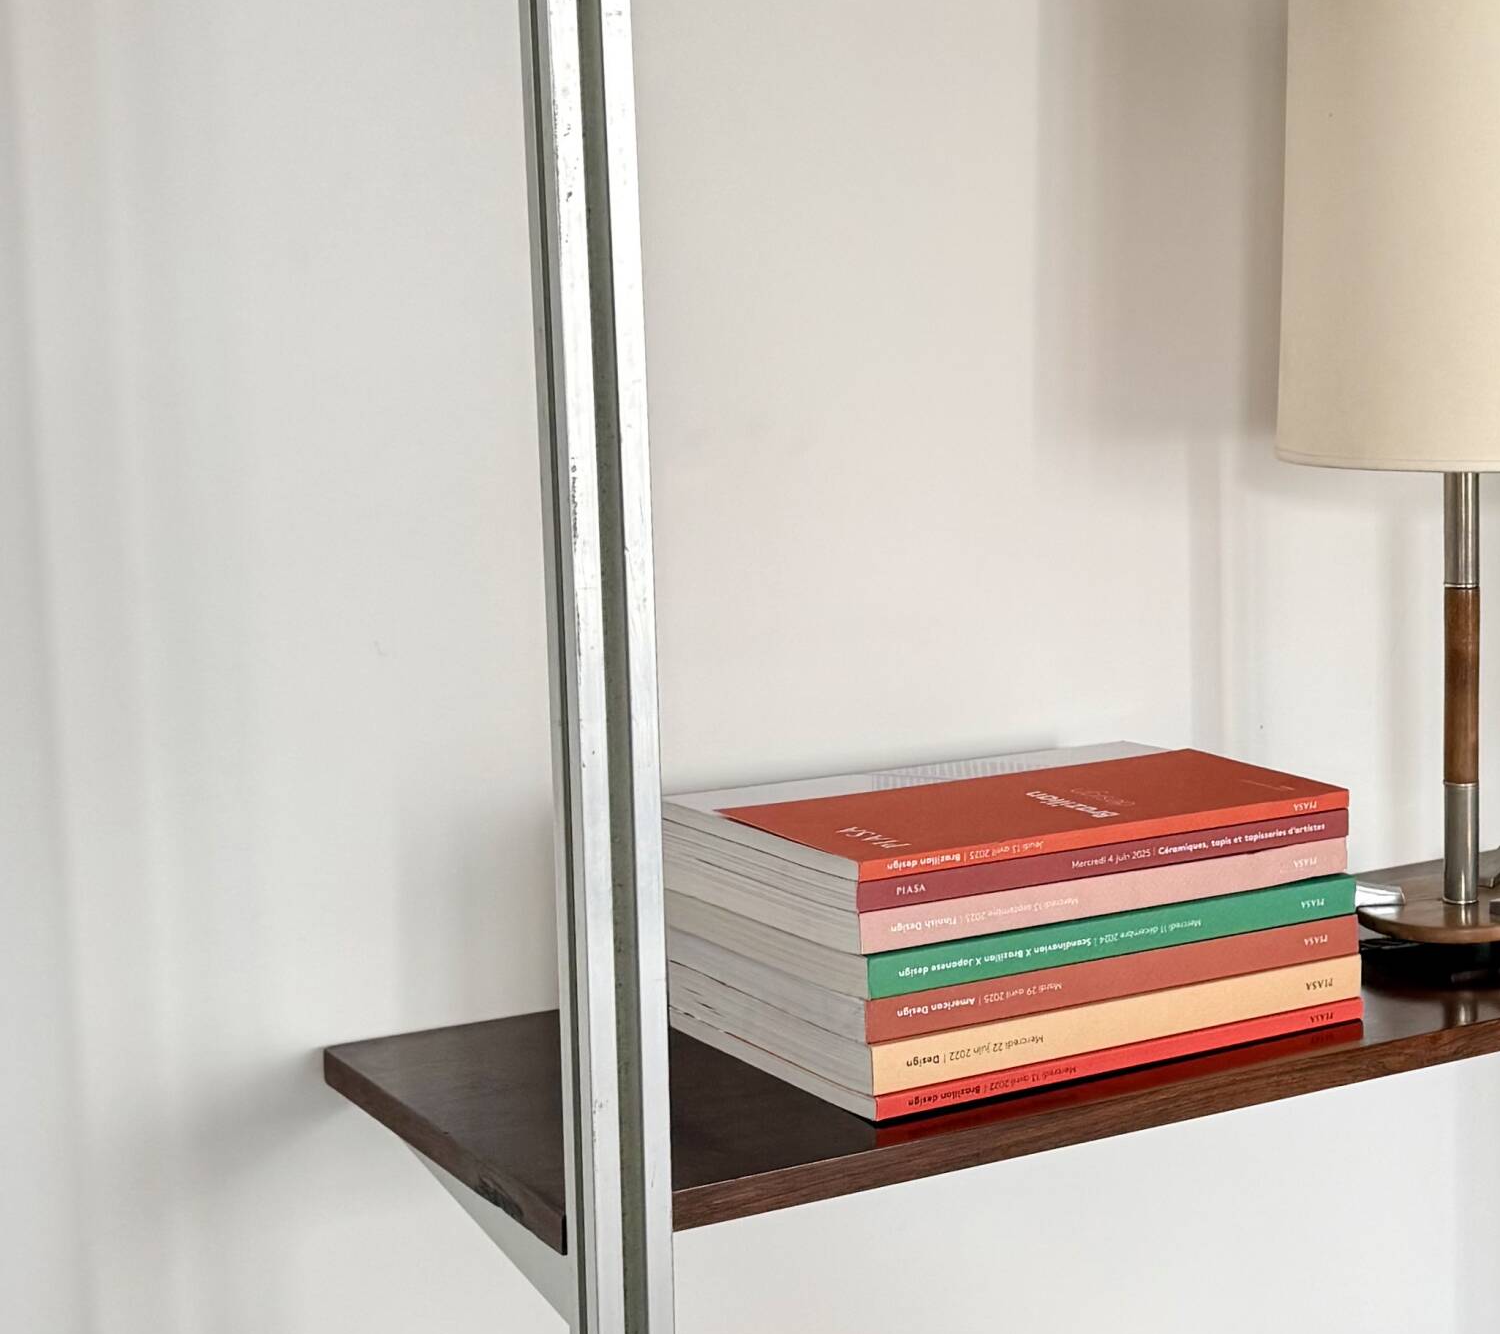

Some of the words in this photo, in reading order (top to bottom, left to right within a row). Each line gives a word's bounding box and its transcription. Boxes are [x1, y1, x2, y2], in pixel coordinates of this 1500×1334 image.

[1025, 790, 1119, 818] Brazilian
[1292, 800, 1317, 811] PIASA
[840, 825, 911, 847] PIASA
[991, 846, 1009, 856] avril
[1022, 840, 1044, 851] Jeudi
[886, 857, 917, 871] design
[895, 883, 925, 894] PIASA
[1071, 855, 1106, 869] Mercredi
[1107, 854, 1113, 862] 4
[1114, 852, 1130, 863] juin
[1131, 848, 1150, 859] 2025
[1157, 839, 1209, 856] Céramiques,
[1210, 836, 1231, 847] tapis
[1233, 835, 1242, 843] et
[1244, 827, 1286, 843] tapisseries
[1287, 822, 1325, 835] d'artistes
[919, 852, 960, 866] Brazilian
[1292, 856, 1317, 867] PIASA
[1043, 896, 1078, 910] Mercredi
[1300, 897, 1324, 908] PIASA
[986, 901, 1032, 918] septembre
[890, 919, 921, 934] Design
[924, 915, 957, 928] Finnish
[1160, 924, 1167, 932] 11
[1168, 918, 1201, 931] Mercredi
[1098, 932, 1118, 943] 2024
[1119, 925, 1159, 940] décembre
[1033, 937, 1091, 954] Scandinavian
[1303, 934, 1328, 945] PIASA
[983, 949, 1023, 964] Brazilian
[1024, 947, 1032, 956] X
[930, 956, 973, 972] Japanese
[975, 957, 982, 965] X
[897, 963, 929, 979] design
[1026, 985, 1037, 994] 29
[1037, 981, 1062, 993] Mardi
[1305, 977, 1333, 990] PIASA
[983, 992, 1005, 1003] 2025
[1005, 988, 1024, 999] avril
[896, 1003, 928, 1018] Design
[930, 997, 975, 1012] American
[1309, 1011, 1333, 1022] PIASA
[991, 1042, 1003, 1052] 22
[1004, 1034, 1044, 1049] Mercredi
[948, 1048, 971, 1061] 2022
[972, 1042, 991, 1056] juin
[905, 1052, 939, 1069] Design
[1041, 1065, 1076, 1079] Mercredi
[989, 1079, 1009, 1090] 2022
[1009, 1074, 1030, 1086] avril
[907, 1092, 938, 1107] design
[939, 1085, 981, 1101] Brazilian
